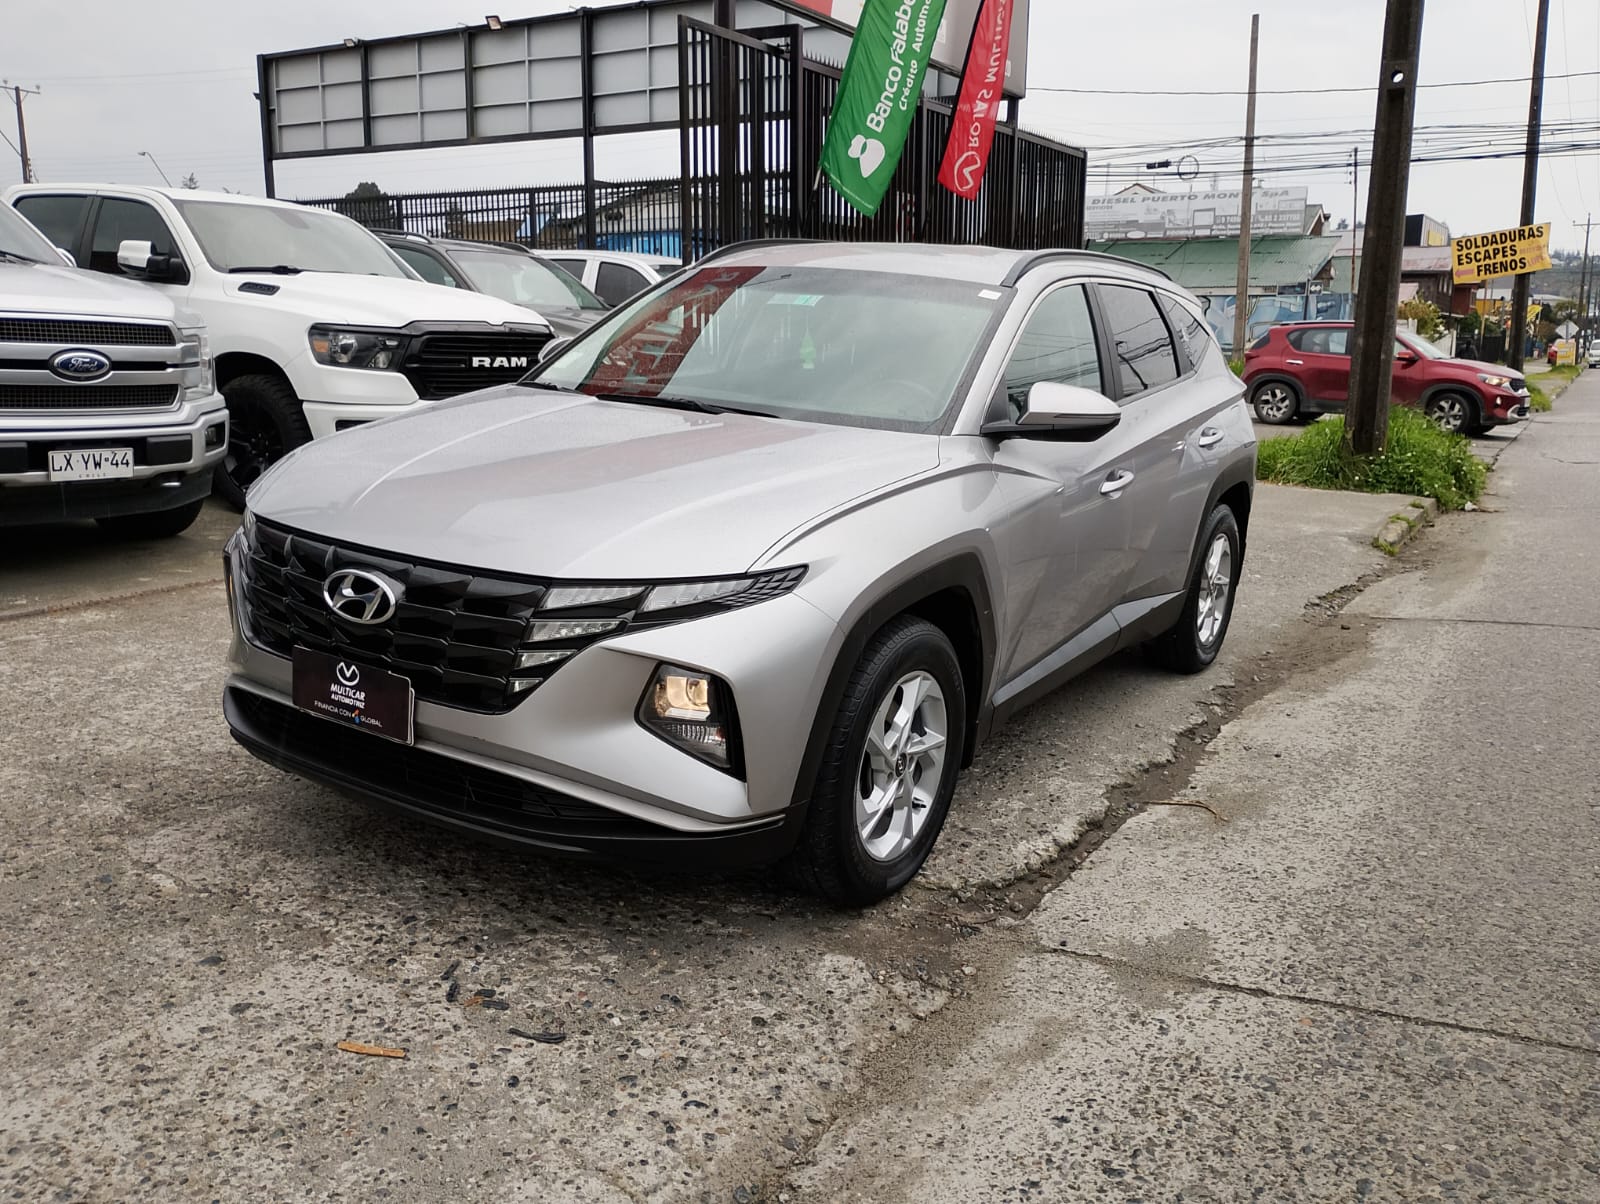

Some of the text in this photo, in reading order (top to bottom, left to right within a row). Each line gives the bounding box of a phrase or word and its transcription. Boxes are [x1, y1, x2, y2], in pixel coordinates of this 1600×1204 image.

[899, 59, 917, 111] Crédito
[867, 66, 901, 133] Banco
[1091, 197, 1136, 205] DIESEL
[1141, 194, 1198, 203] PUERTO
[1203, 191, 1257, 200] MONT
[1456, 225, 1544, 252] SOLDADURAS
[1457, 244, 1518, 266] ESCAPES
[1476, 257, 1526, 277] FRENOS
[472, 356, 527, 368] RAM
[330, 683, 366, 701] MULTICAR
[331, 693, 365, 709] AUTOMOTRIZ
[314, 700, 383, 728] FINANCIA CON GLOBAL
